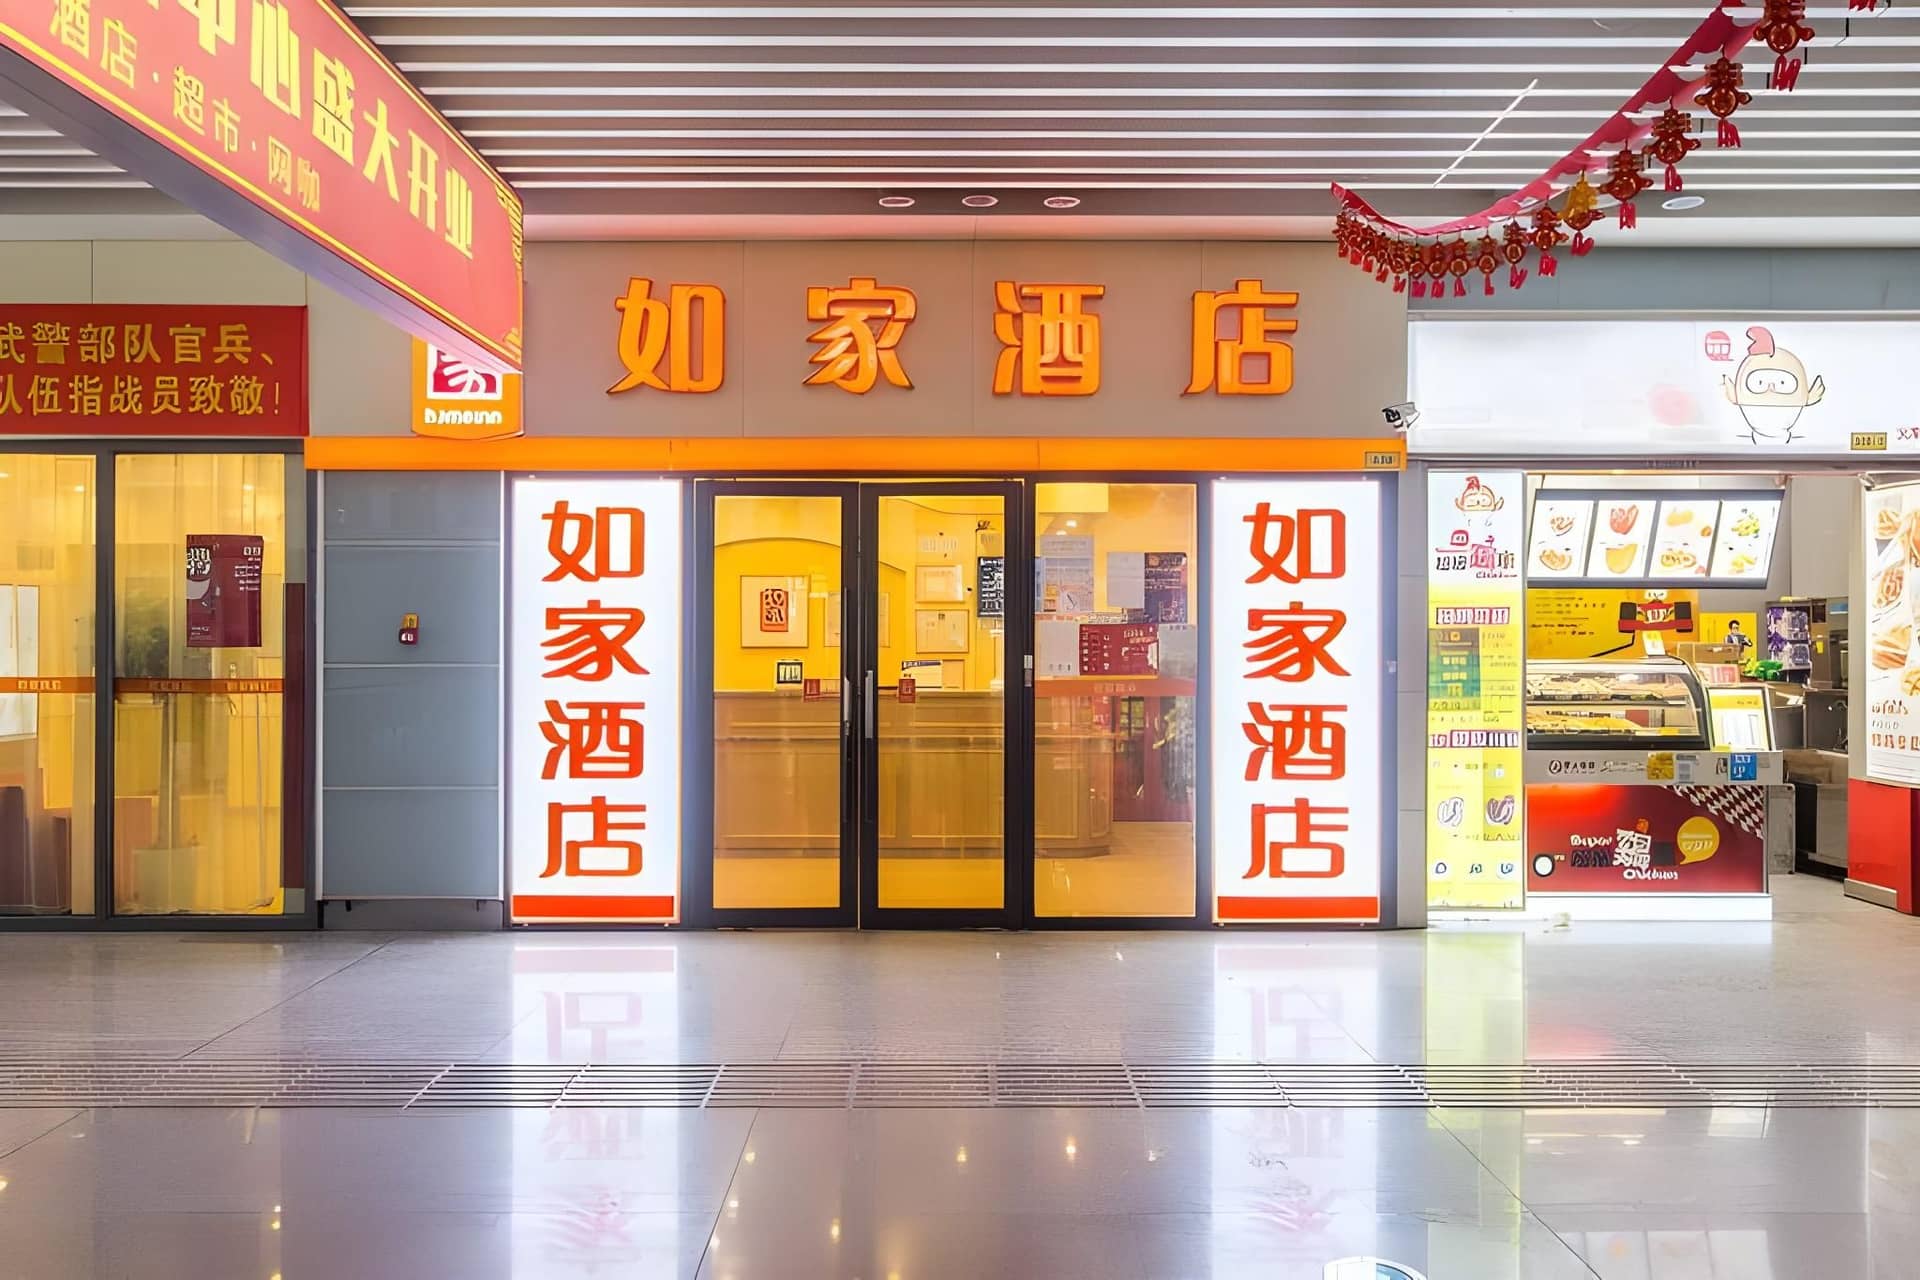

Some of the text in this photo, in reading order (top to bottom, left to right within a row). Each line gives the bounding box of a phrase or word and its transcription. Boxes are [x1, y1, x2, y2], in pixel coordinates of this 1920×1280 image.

[146, 0, 474, 260] 心盛大开业
[605, 276, 1303, 397] 如家酒店
[538, 500, 650, 879] 如家酒店
[1242, 502, 1352, 879] 如家酒店
